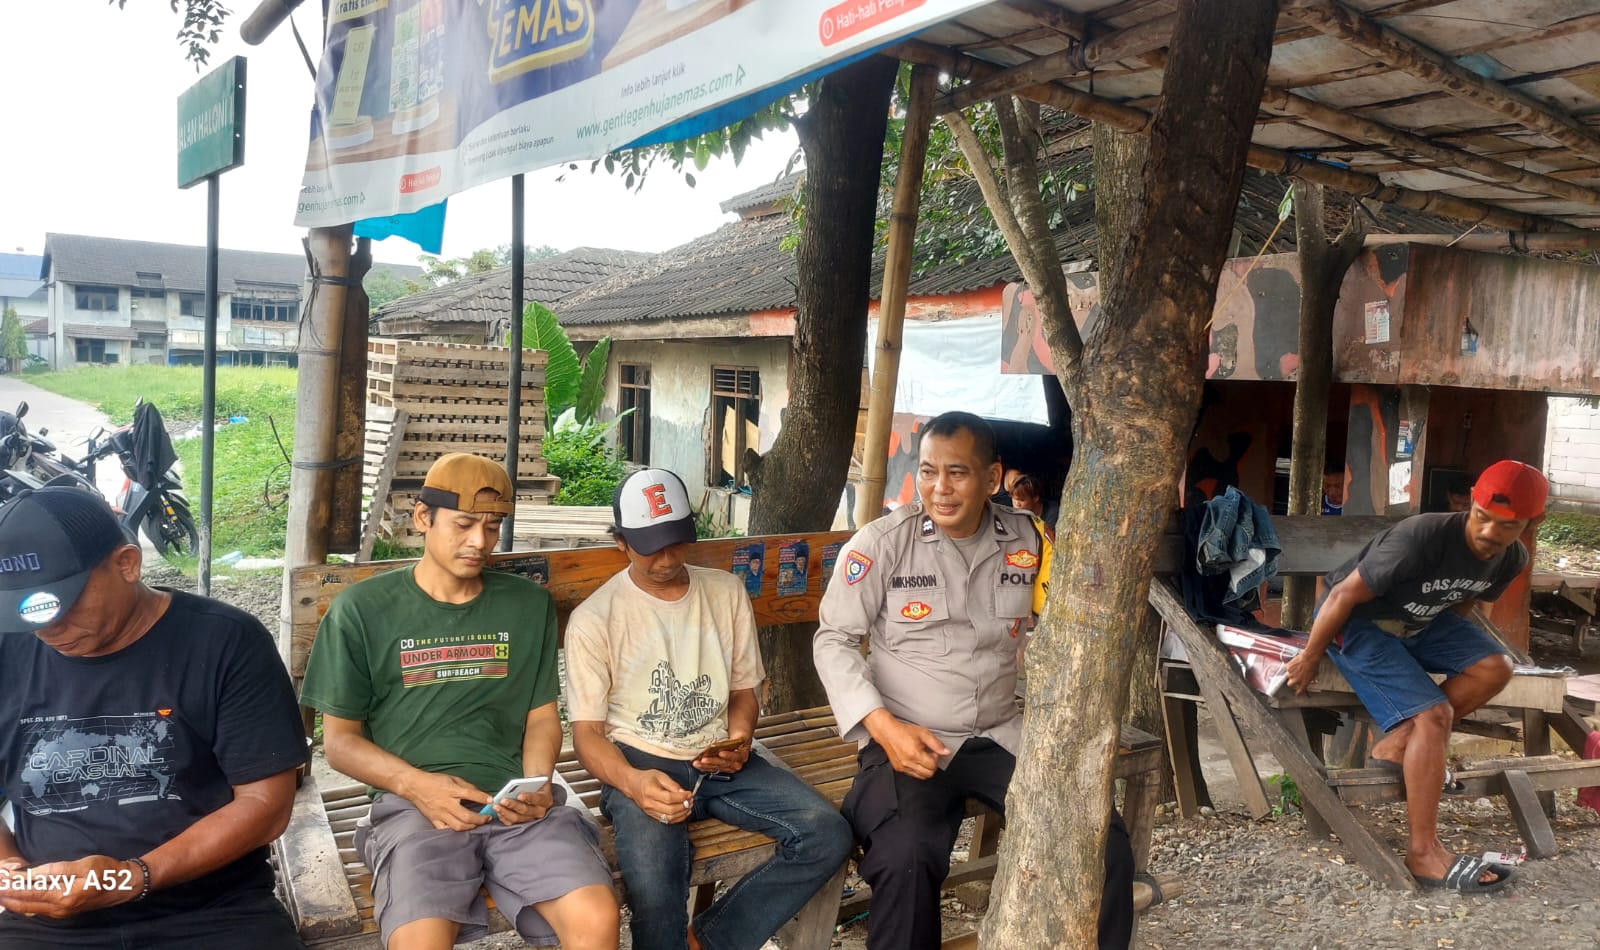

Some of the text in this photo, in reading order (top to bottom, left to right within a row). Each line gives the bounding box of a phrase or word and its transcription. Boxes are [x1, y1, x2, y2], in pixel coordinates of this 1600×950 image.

[499, 0, 584, 56] EMAS
[836, 2, 877, 30] Hati-hati
[620, 61, 686, 98] Info lebih lanjut klik
[576, 71, 733, 140] www.gentlegenhujanemas.com
[642, 483, 672, 518] E
[1421, 579, 1450, 594] GAS
[400, 638, 415, 650] CO
[435, 635, 465, 644] FUTURE
[402, 647, 492, 665] UNDER ARMOUR
[29, 746, 165, 771] CARDINAL
[52, 763, 147, 784] CASUAL
